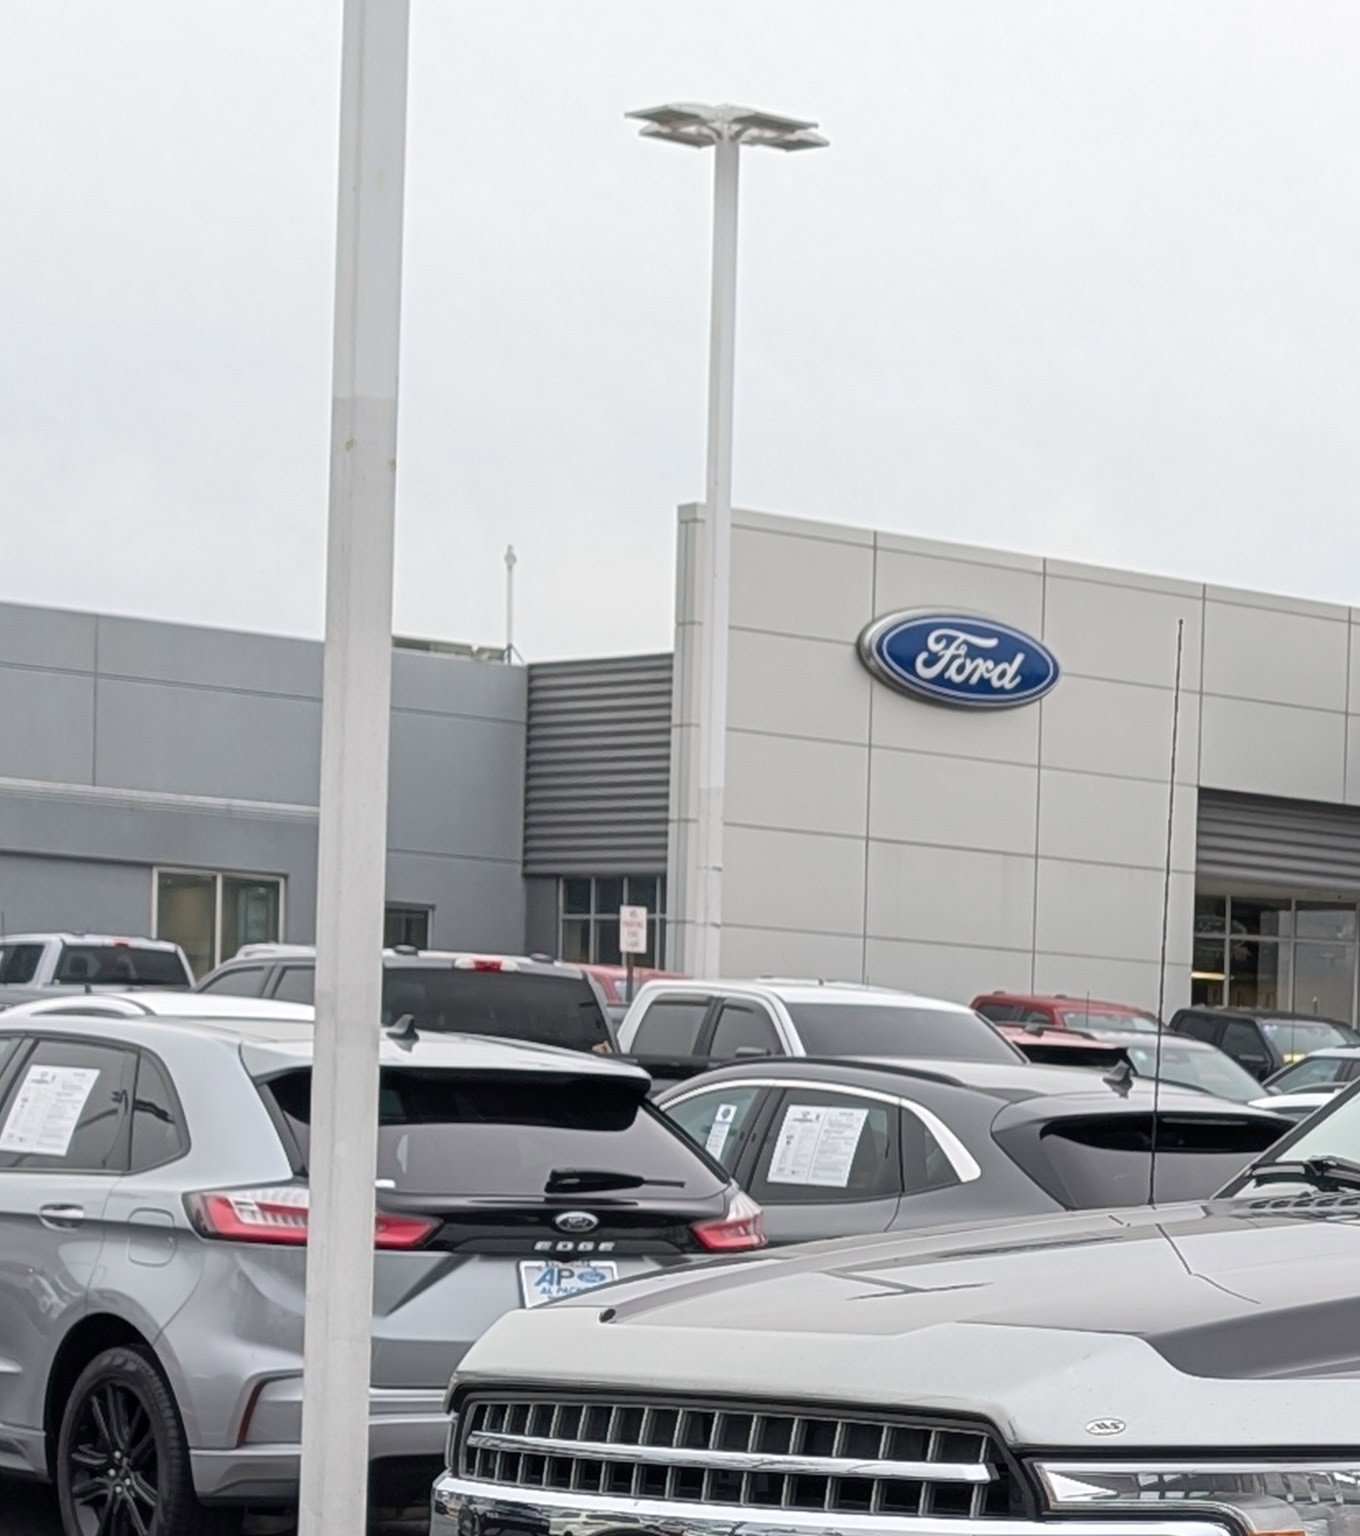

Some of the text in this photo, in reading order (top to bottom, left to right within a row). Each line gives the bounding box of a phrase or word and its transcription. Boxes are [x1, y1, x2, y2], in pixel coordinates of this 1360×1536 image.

[915, 628, 1025, 690] Ford
[534, 1241, 616, 1252] EDGE
[534, 1267, 575, 1287] AP
